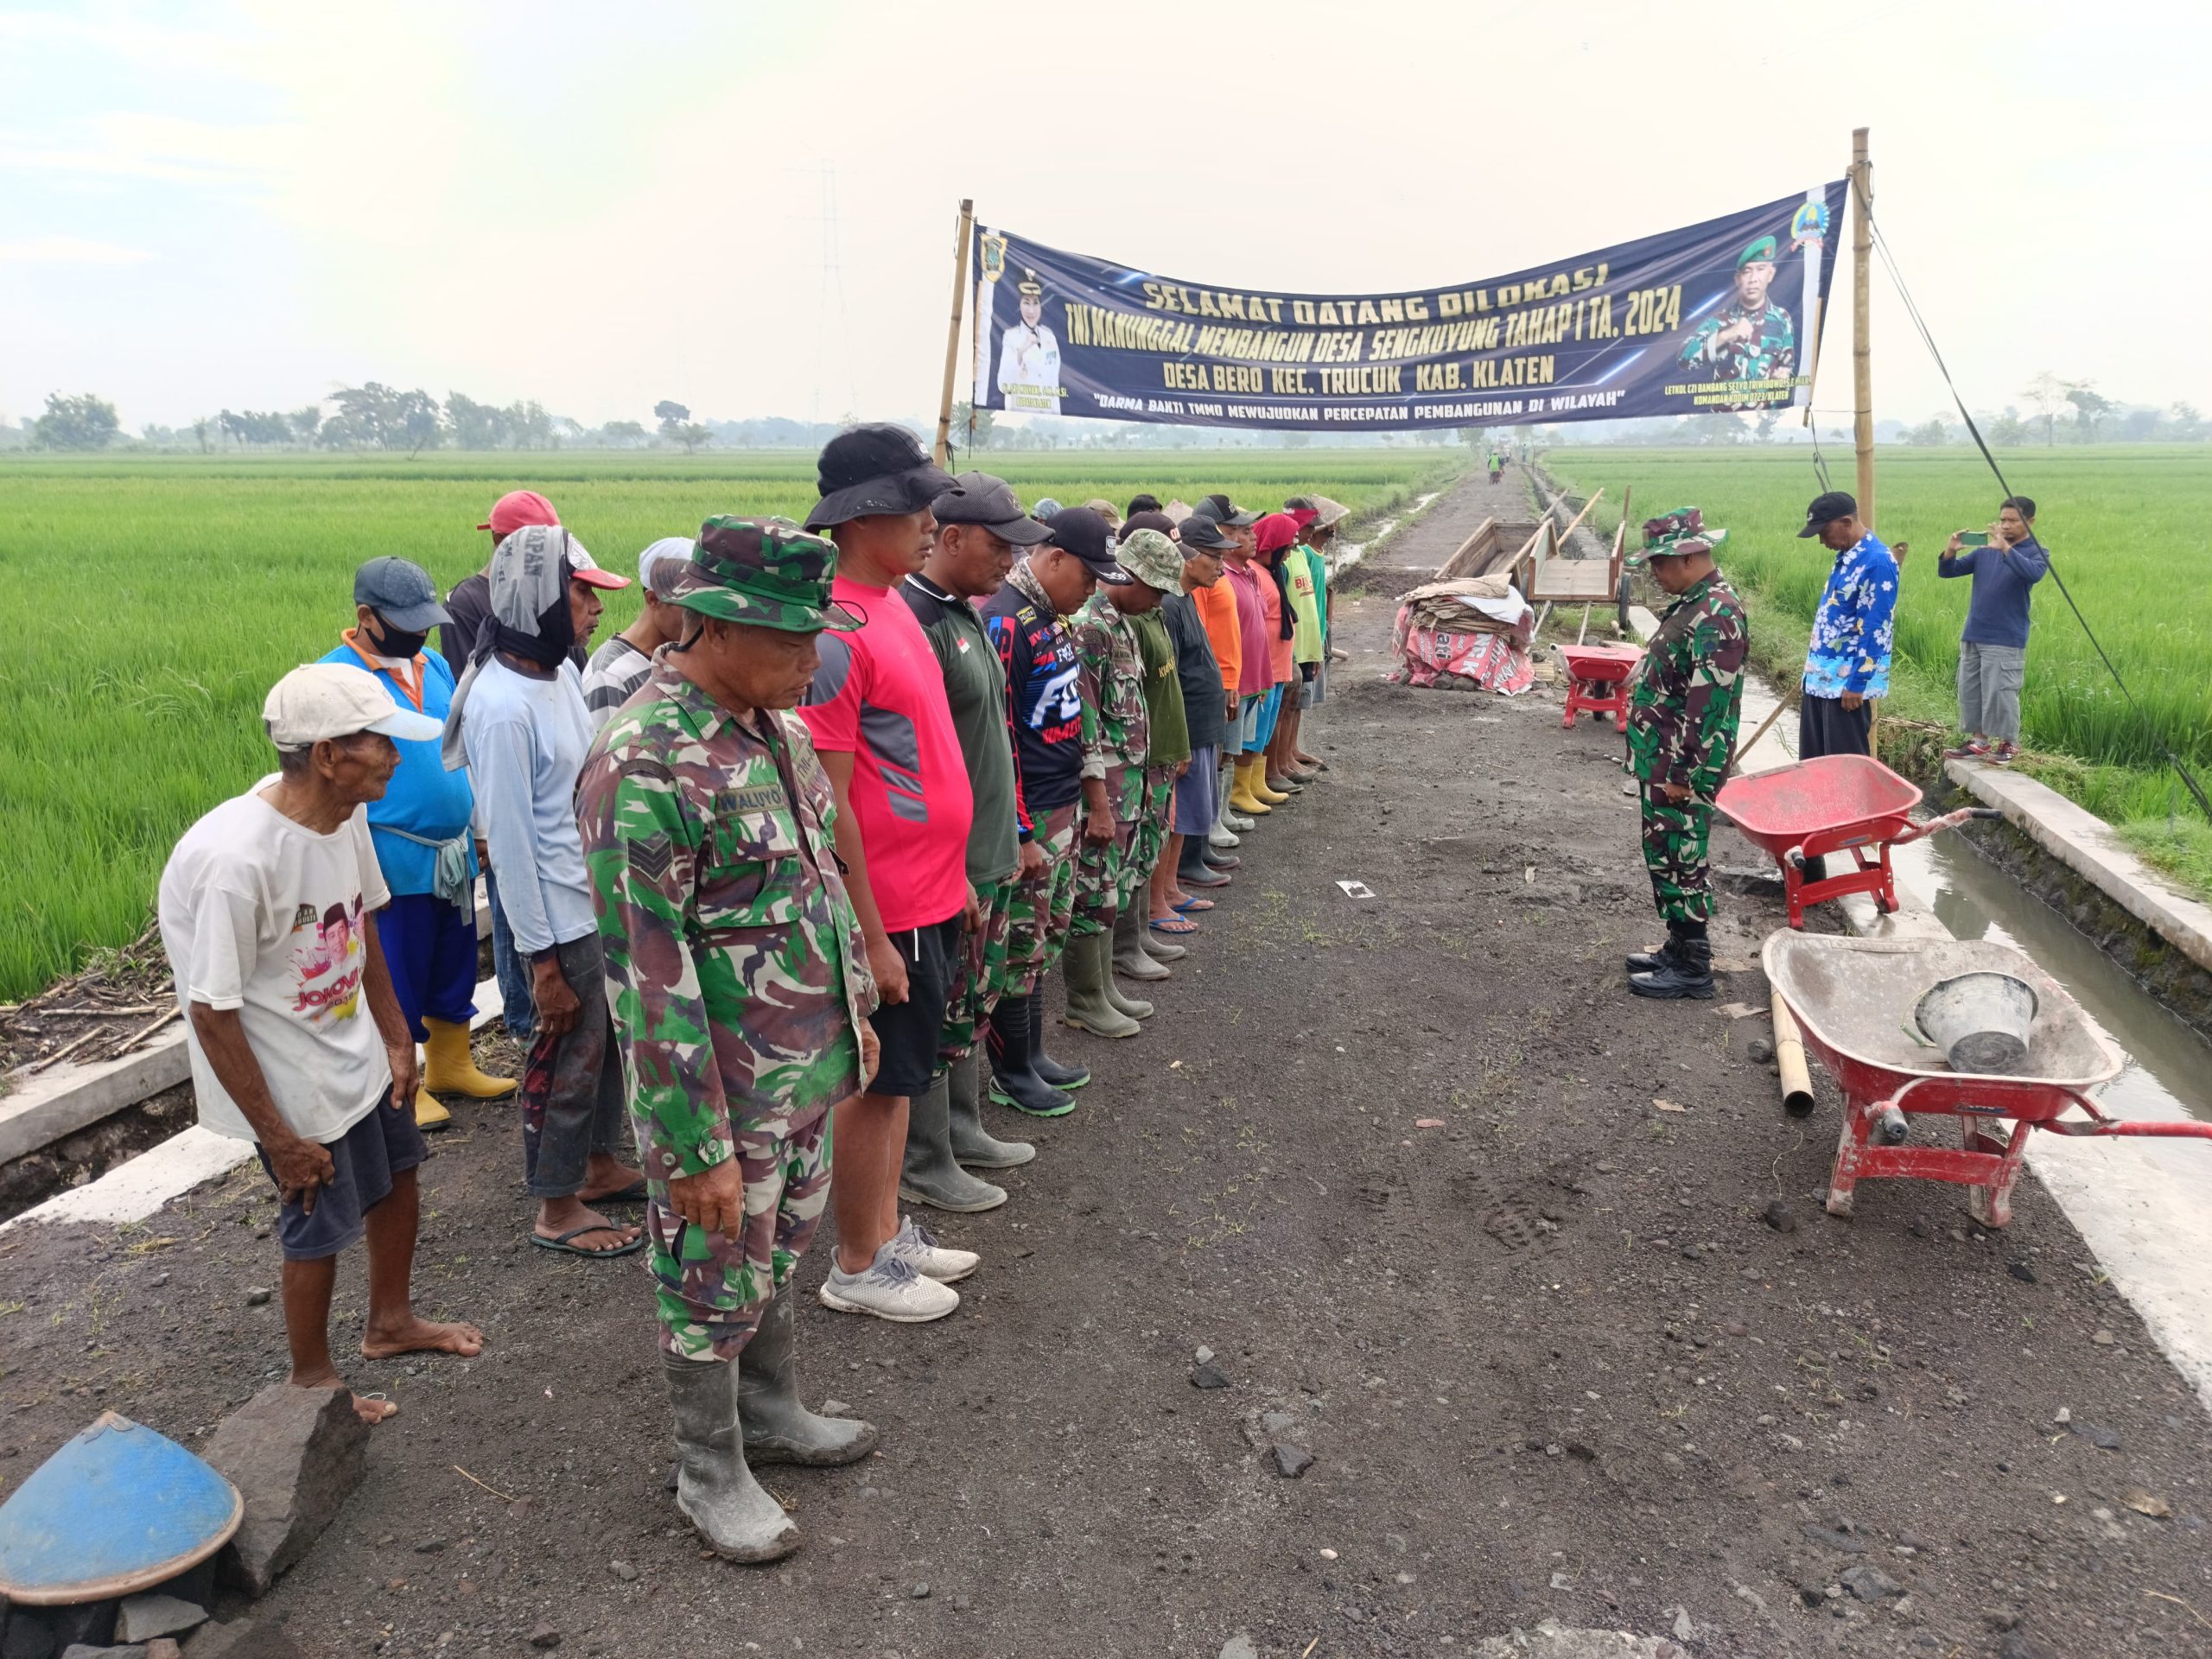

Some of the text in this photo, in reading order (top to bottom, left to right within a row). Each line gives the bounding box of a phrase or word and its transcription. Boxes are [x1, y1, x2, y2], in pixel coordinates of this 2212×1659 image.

[1142, 263, 1609, 326] SELAMAT DATANG DILOKASI
[1065, 302, 1090, 346] TNI
[1091, 306, 1195, 353] MANUNGGAL
[1193, 324, 1316, 363] MEMBANGUN
[1312, 331, 1363, 363] DESA
[1369, 316, 1501, 361] SENGKUYUNG
[1505, 302, 1573, 347] TAHAP
[1589, 294, 1619, 340] TA.
[1624, 284, 1681, 336] 2024
[1163, 355, 1554, 394] DESA BERO KEC. TRUCUK KAB. KLATEN
[1093, 392, 1142, 411] "DARMA
[1148, 399, 1185, 415] BAKTI
[1227, 404, 1319, 422] MEWUJUDKAN
[1324, 406, 1408, 421] PERCEPATAN
[1414, 400, 1522, 419] PEMBANGUNAN
[1528, 398, 1544, 412] DI
[1551, 390, 1626, 410] WILAYAH"
[721, 788, 782, 811] WALUYO
